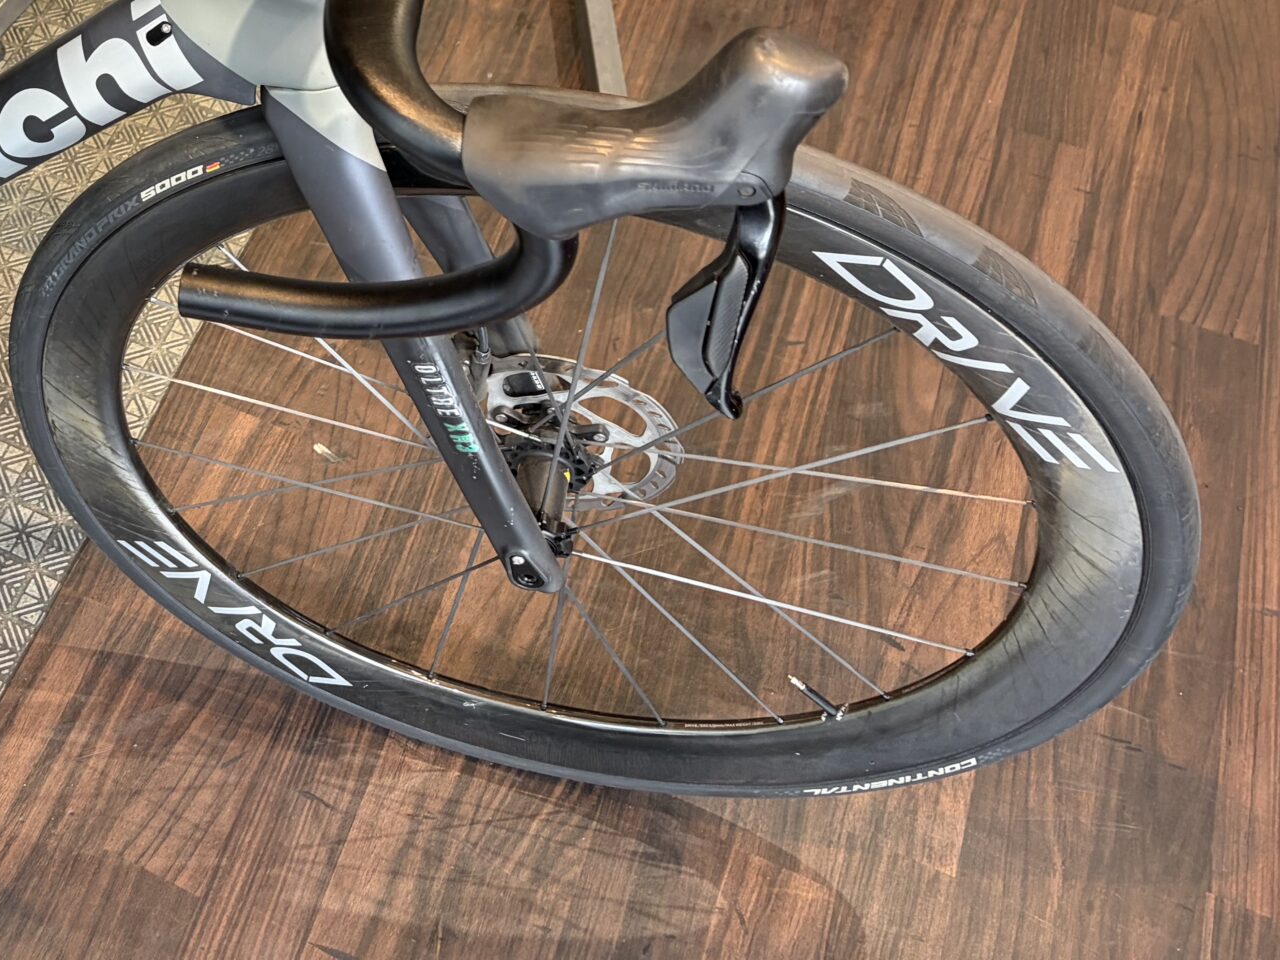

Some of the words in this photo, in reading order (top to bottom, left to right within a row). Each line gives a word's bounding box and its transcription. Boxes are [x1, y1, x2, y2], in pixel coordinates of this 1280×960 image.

[96, 194, 142, 233] PRIX
[140, 164, 204, 202] 5000
[811, 250, 1120, 473] DRIVE
[116, 539, 354, 688] DRIVE
[802, 757, 978, 796] CONTINENTAL
